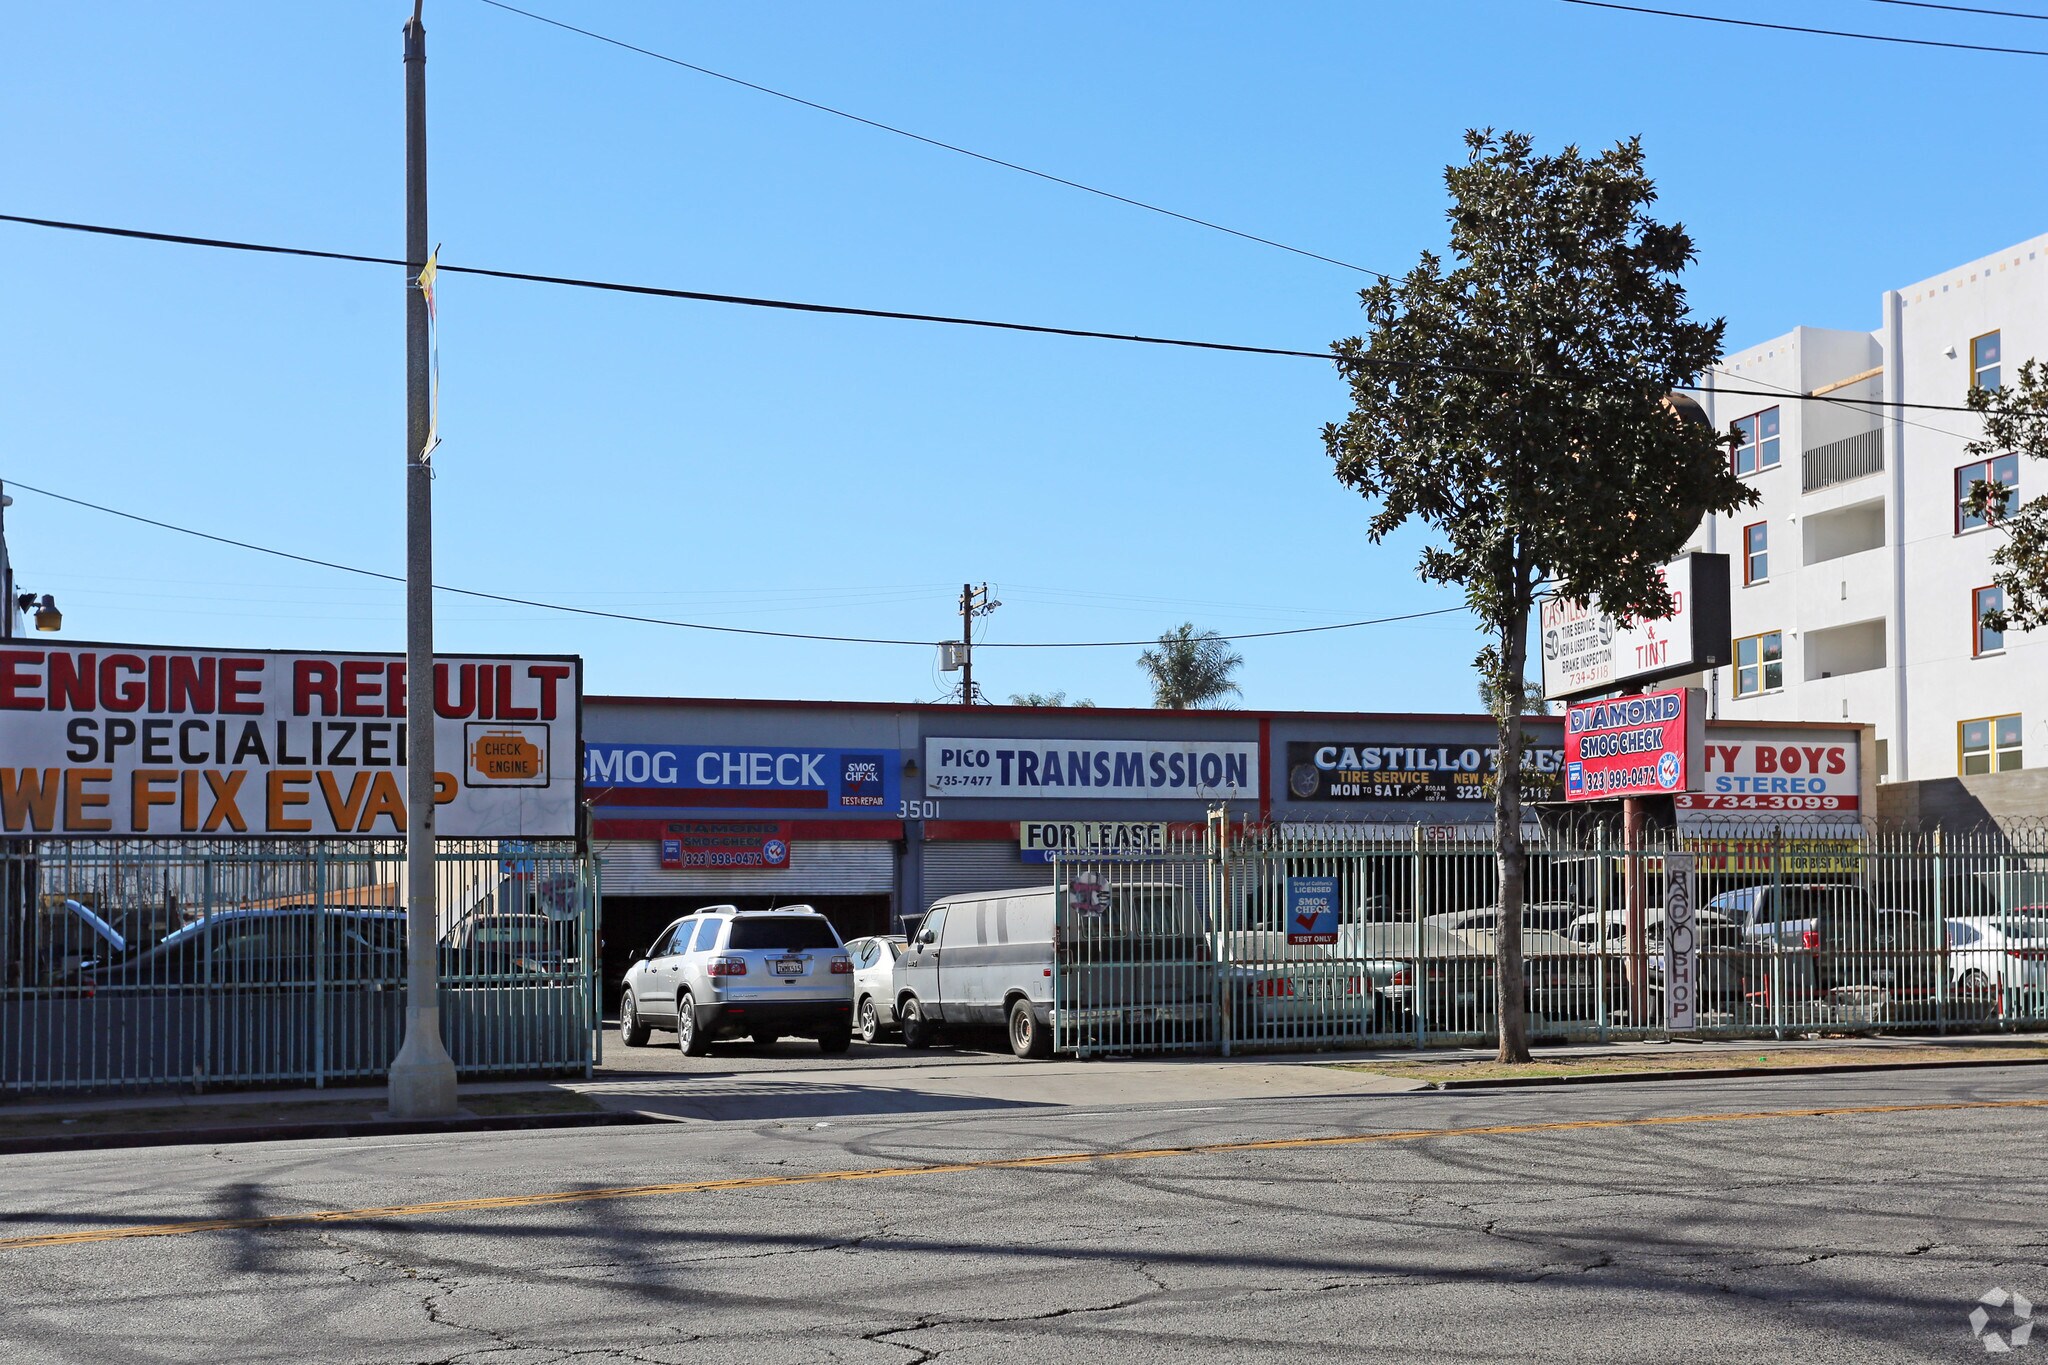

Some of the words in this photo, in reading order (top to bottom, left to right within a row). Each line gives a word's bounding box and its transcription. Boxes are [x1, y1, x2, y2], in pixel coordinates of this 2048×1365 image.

[1561, 624, 1574, 639] TIRE
[1574, 618, 1596, 636] SERVICE
[1648, 626, 1656, 639] &
[1560, 642, 1569, 657] NEW
[1574, 637, 1586, 653] USED
[1586, 634, 1599, 649] TIRES
[1561, 657, 1580, 674] BRAKE
[1580, 648, 1612, 669] INSPECTION
[1635, 639, 1668, 669] TINT
[0, 651, 265, 716] ENGINE
[1569, 665, 1609, 687] 734-5118
[1569, 694, 1680, 734] DIAMOND
[66, 717, 407, 767] SPECIALIZE
[485, 743, 521, 755] CHECK
[1580, 732, 1619, 760] SMOG
[1619, 727, 1664, 755] CHECK
[1313, 746, 1482, 772] CASTILLO
[1755, 746, 1846, 775] BOYS
[489, 761, 528, 773] ENGINE
[696, 751, 827, 787] CHECK
[848, 763, 876, 772] SMOG
[941, 749, 990, 768] PICO
[996, 749, 1248, 788] TRANSMSSION
[845, 771, 879, 782] CHECK
[935, 775, 992, 787] 735-7477
[1338, 771, 1370, 783] TIRE
[1373, 771, 1430, 784] SERVICE
[1453, 773, 1479, 785] NEW
[1331, 784, 1360, 796] MON
[1363, 786, 1372, 794] TO
[1374, 784, 1404, 797] SAT.
[1407, 784, 1421, 798] FROM
[1456, 785, 1483, 799] 323
[1715, 776, 1827, 794] STEREO
[0, 768, 112, 832] WE
[131, 770, 248, 832] FIX
[842, 796, 858, 806] TEST
[860, 796, 884, 806] REPAIR
[1704, 795, 1840, 810] 734-3099
[896, 800, 940, 819] 3501
[667, 823, 778, 834] DIAMOND
[1027, 824, 1076, 848] FOR
[1086, 825, 1161, 848] LEASE
[683, 837, 719, 847] SMOG
[722, 837, 763, 847] CHECK
[1294, 886, 1332, 894] LICENSED
[1298, 897, 1328, 906] SMOG
[1295, 905, 1332, 914] CHECK
[1294, 935, 1312, 943] TEST
[1313, 935, 1332, 943] ONLY
